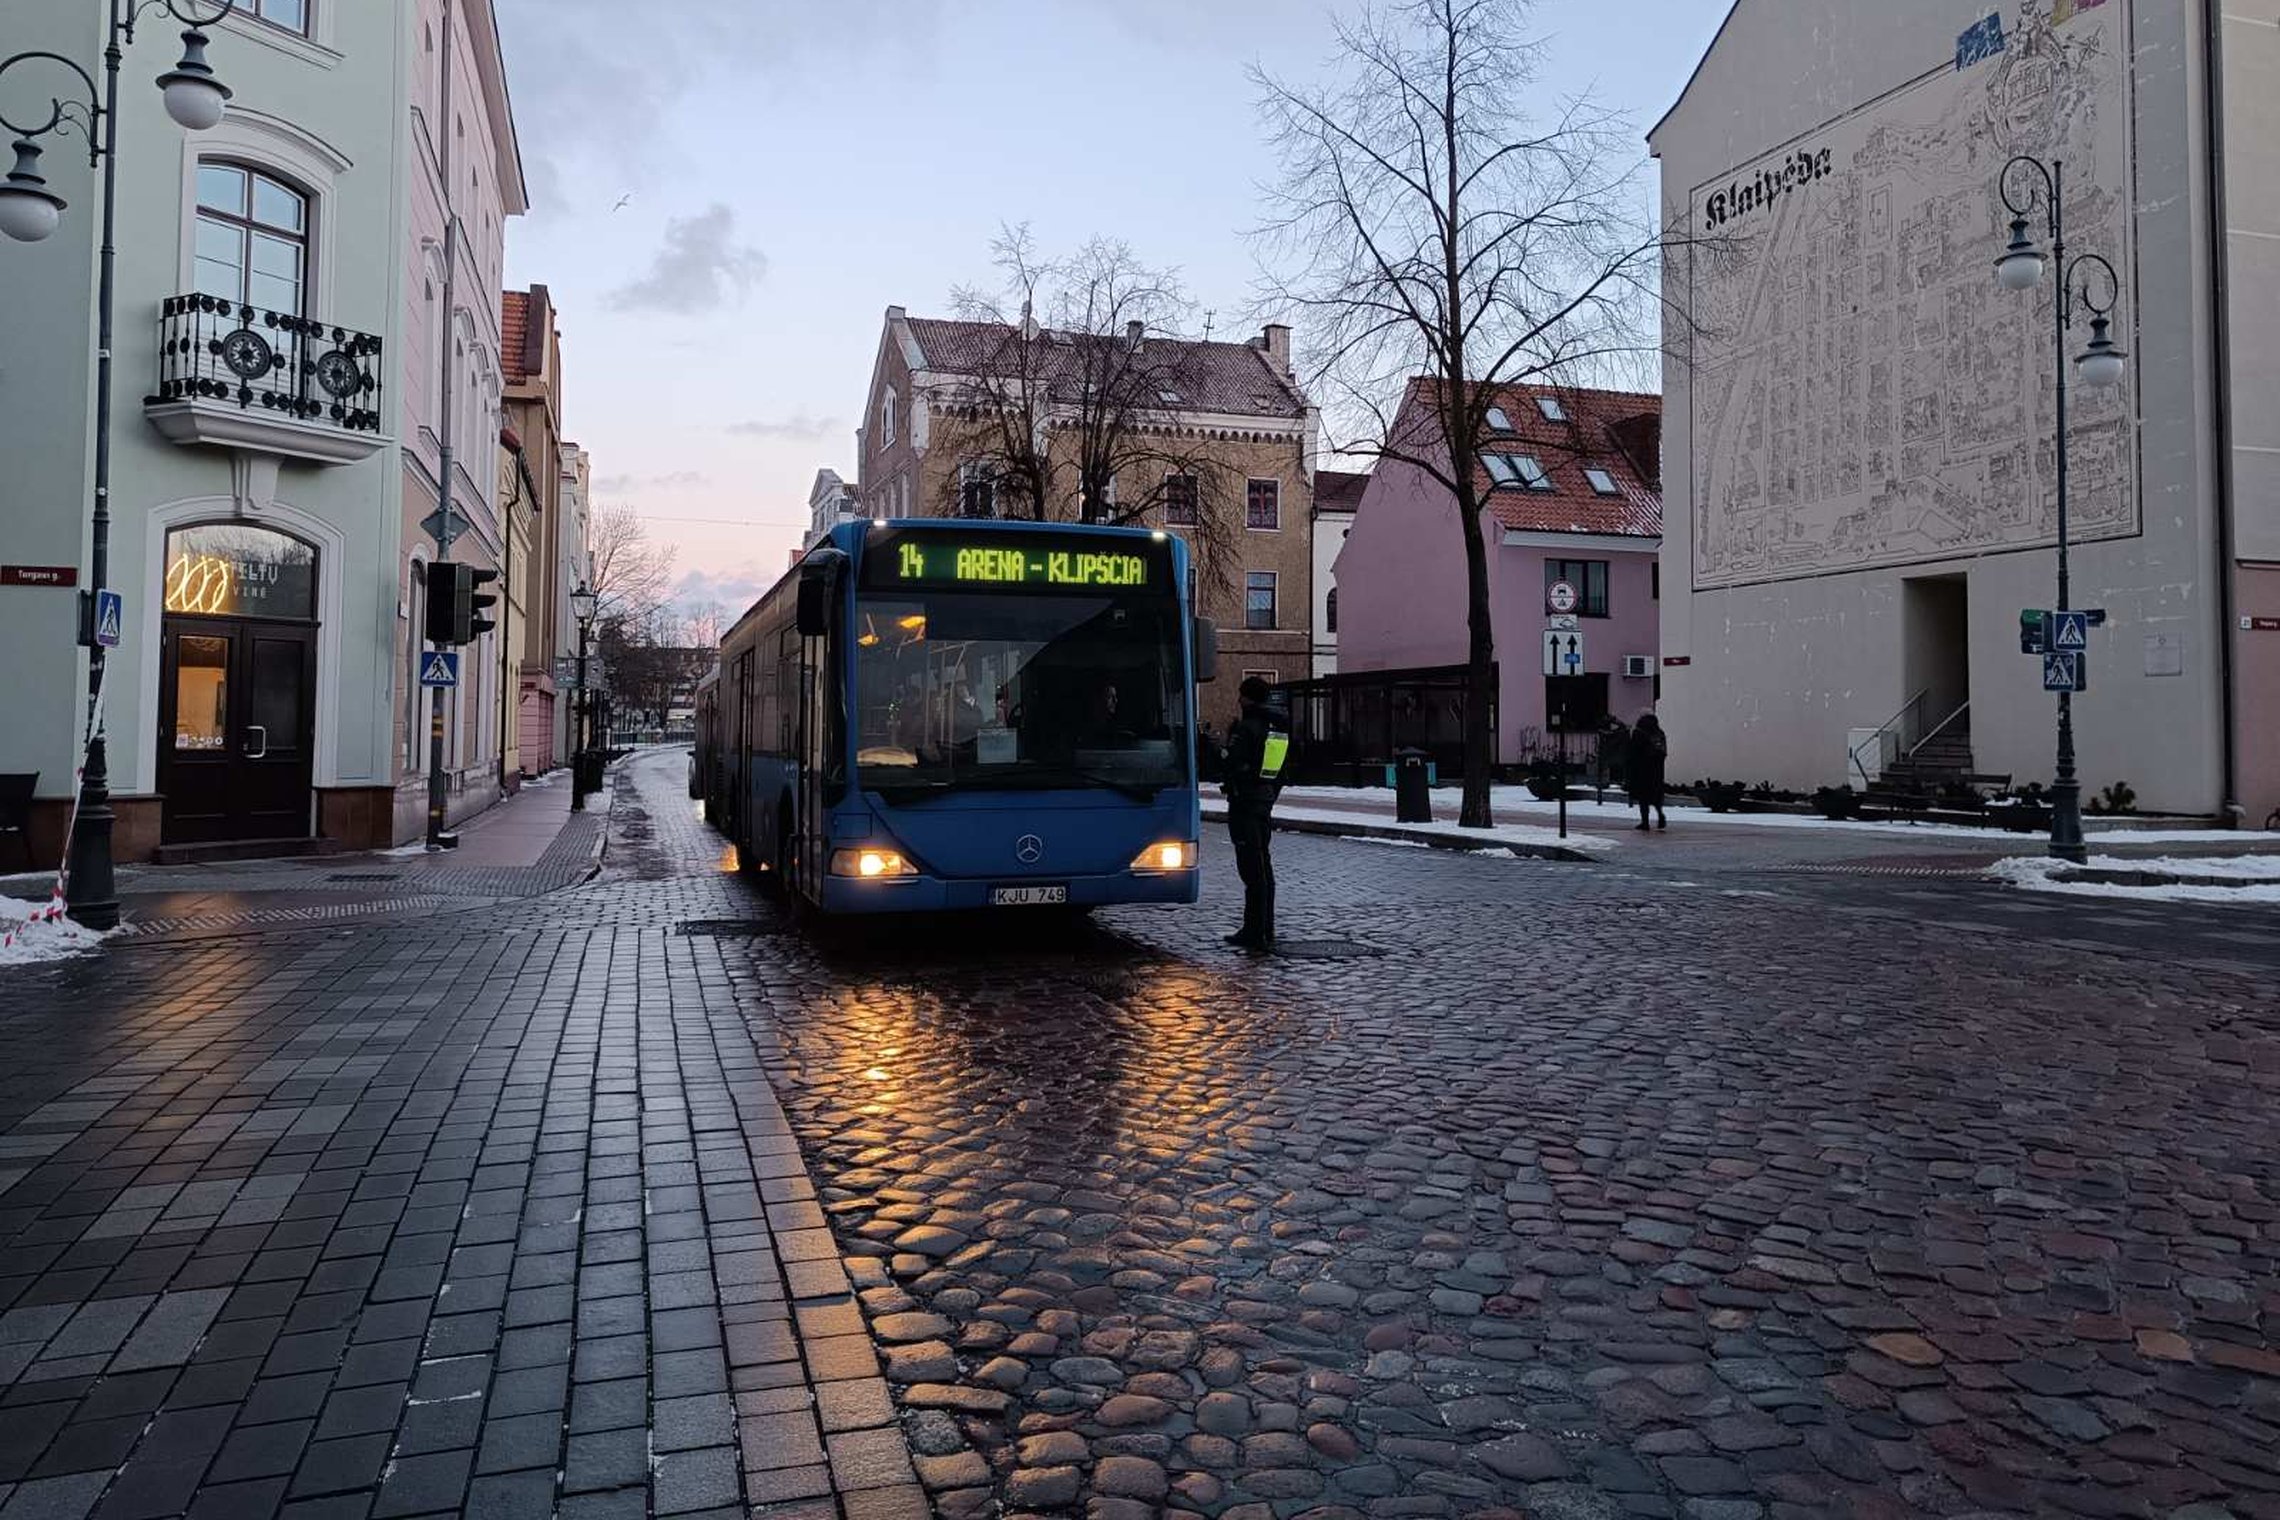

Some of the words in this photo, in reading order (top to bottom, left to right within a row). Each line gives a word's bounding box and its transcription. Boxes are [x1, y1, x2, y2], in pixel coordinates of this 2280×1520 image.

[899, 543, 924, 578] 14
[957, 548, 1025, 582] ARENA
[999, 888, 1029, 903] KJU
[1039, 887, 1065, 902] 749
